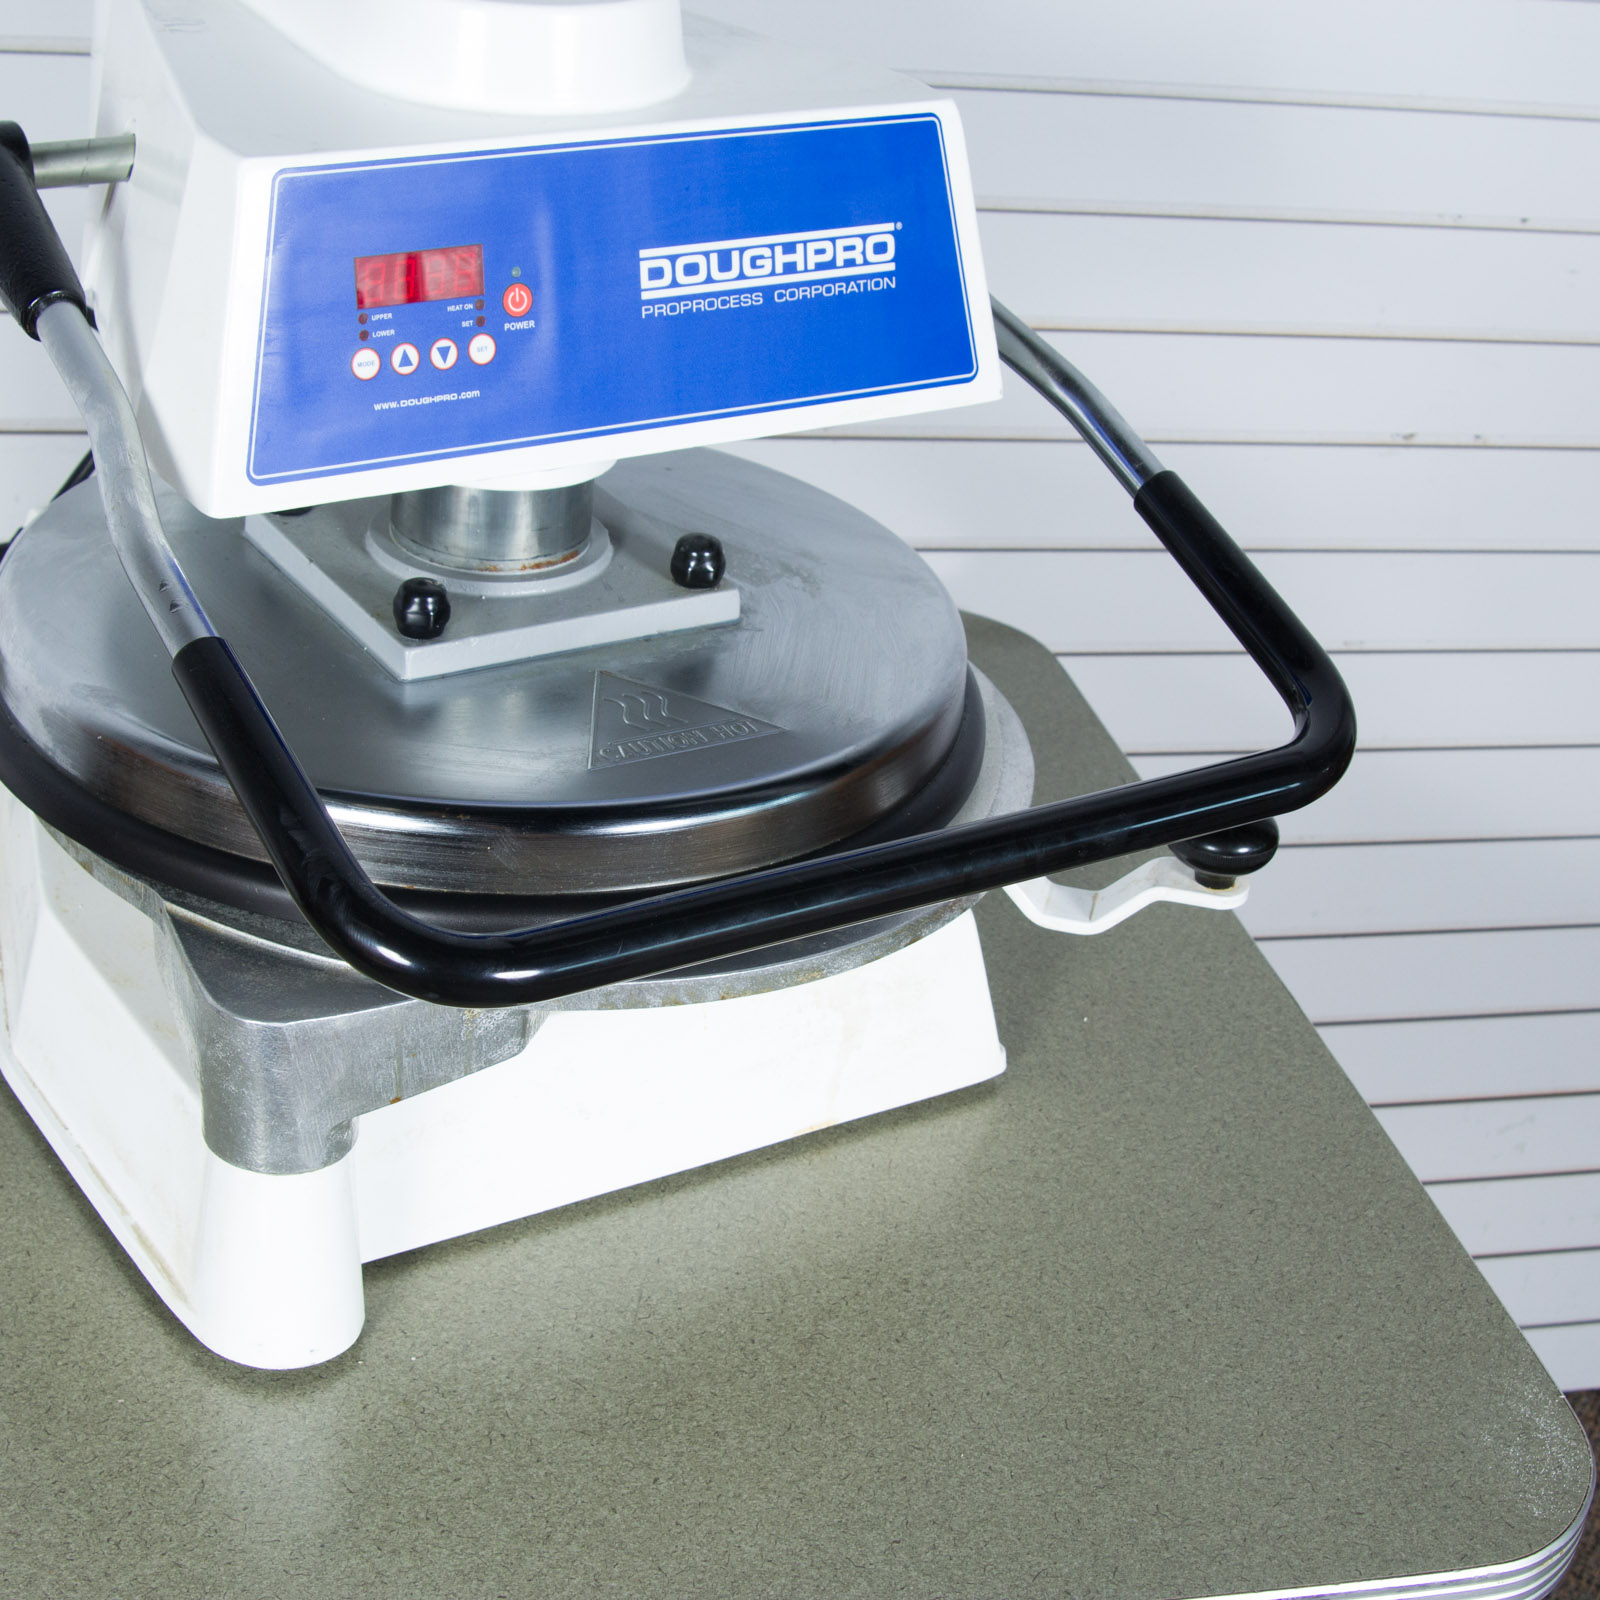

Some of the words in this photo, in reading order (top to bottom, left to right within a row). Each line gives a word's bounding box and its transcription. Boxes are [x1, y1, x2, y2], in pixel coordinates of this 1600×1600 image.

[639, 233, 895, 290] DOUGHPRO
[641, 292, 763, 319] PROPROCESS
[774, 276, 896, 302] CORPORATION
[447, 304, 462, 312] HEAT
[463, 303, 474, 311] ON
[371, 312, 392, 321] UPPER
[461, 320, 474, 328] SET
[504, 320, 535, 331] POWER
[372, 329, 395, 338] LOWER
[357, 360, 375, 368] MODE
[373, 390, 480, 411] www.DOUGHPRO.com
[598, 729, 708, 762] CAUTION
[710, 720, 759, 740] HOT
